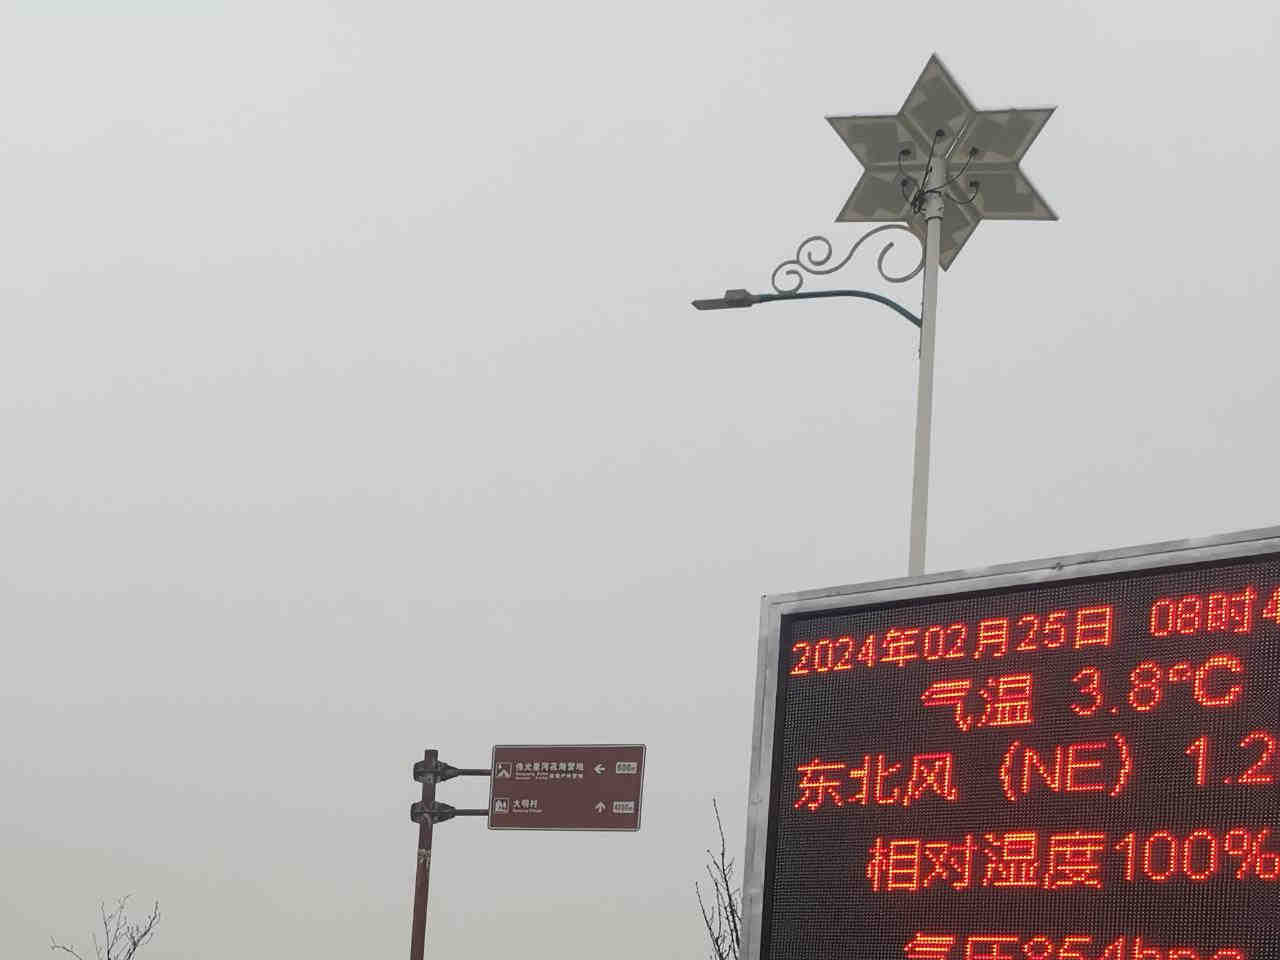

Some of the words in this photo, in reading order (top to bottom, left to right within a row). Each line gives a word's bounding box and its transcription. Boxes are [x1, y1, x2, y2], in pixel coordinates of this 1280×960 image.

[790, 605, 1113, 676] 2024年02月25日
[920, 671, 1035, 732] 气温
[794, 751, 958, 812] 东北风
[865, 829, 1280, 892] 相对湿度100%
